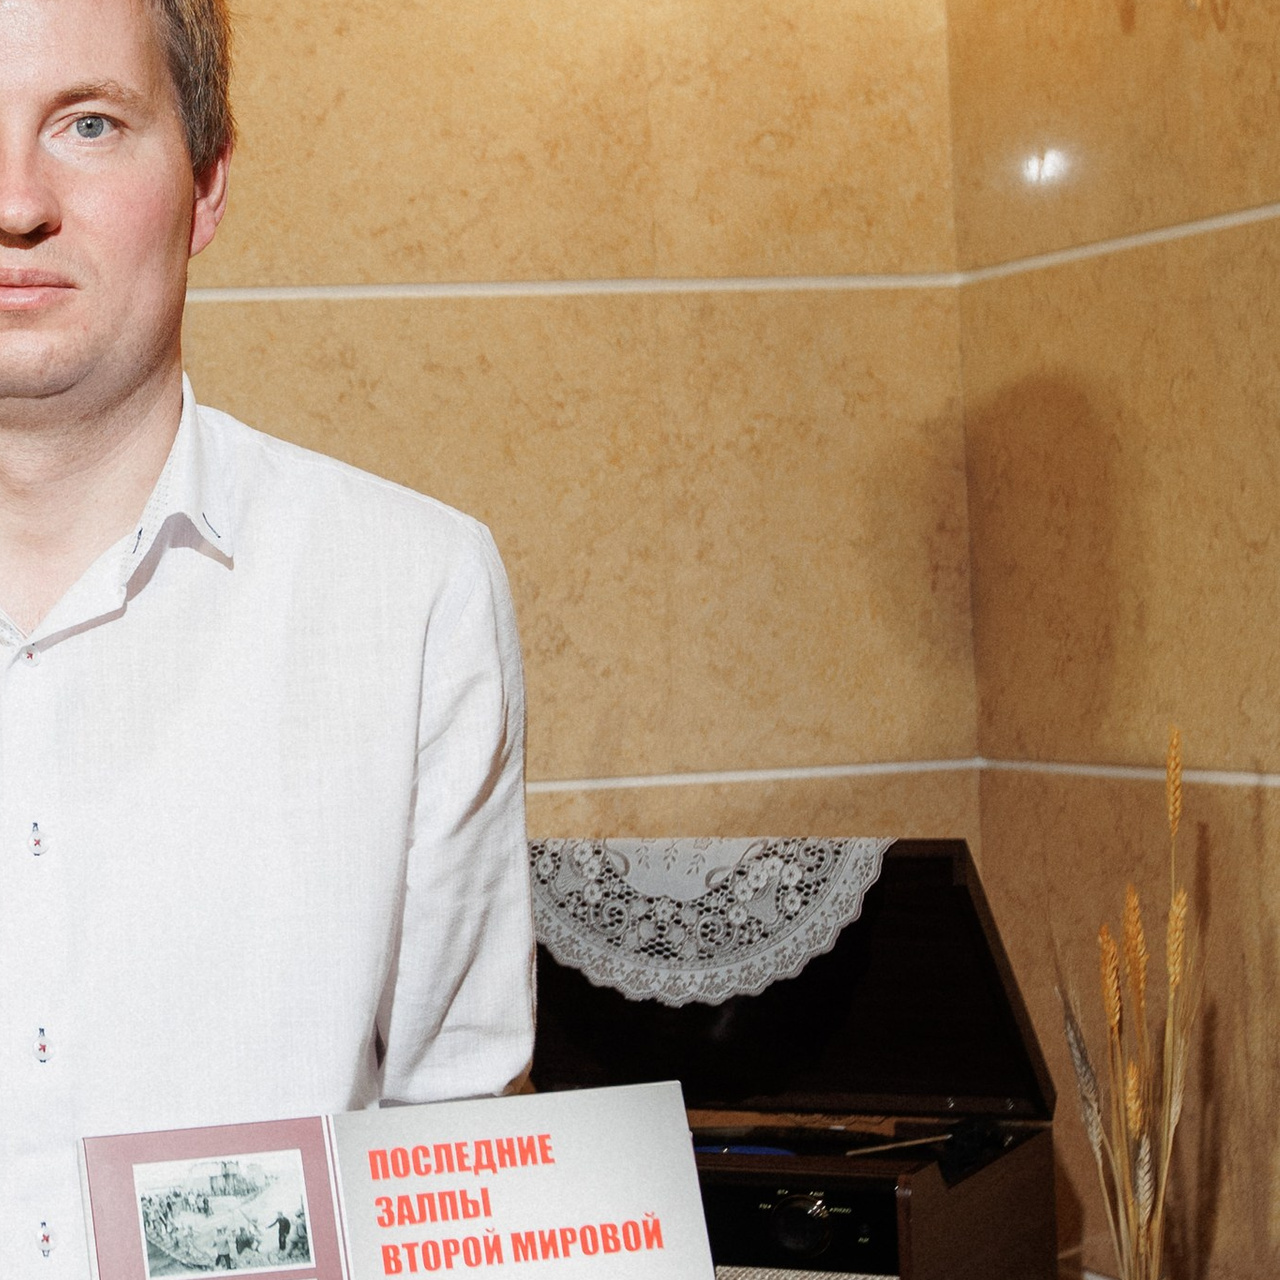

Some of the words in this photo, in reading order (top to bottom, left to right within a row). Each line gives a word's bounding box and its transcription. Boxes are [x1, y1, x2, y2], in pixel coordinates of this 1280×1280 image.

[368, 1134, 555, 1180] ПОСЛЕДНИЕ
[375, 1187, 492, 1228] ЗАЛПЫ
[381, 1227, 503, 1276] ВТОРОЙ
[511, 1212, 664, 1261] МИРОВОЙ
